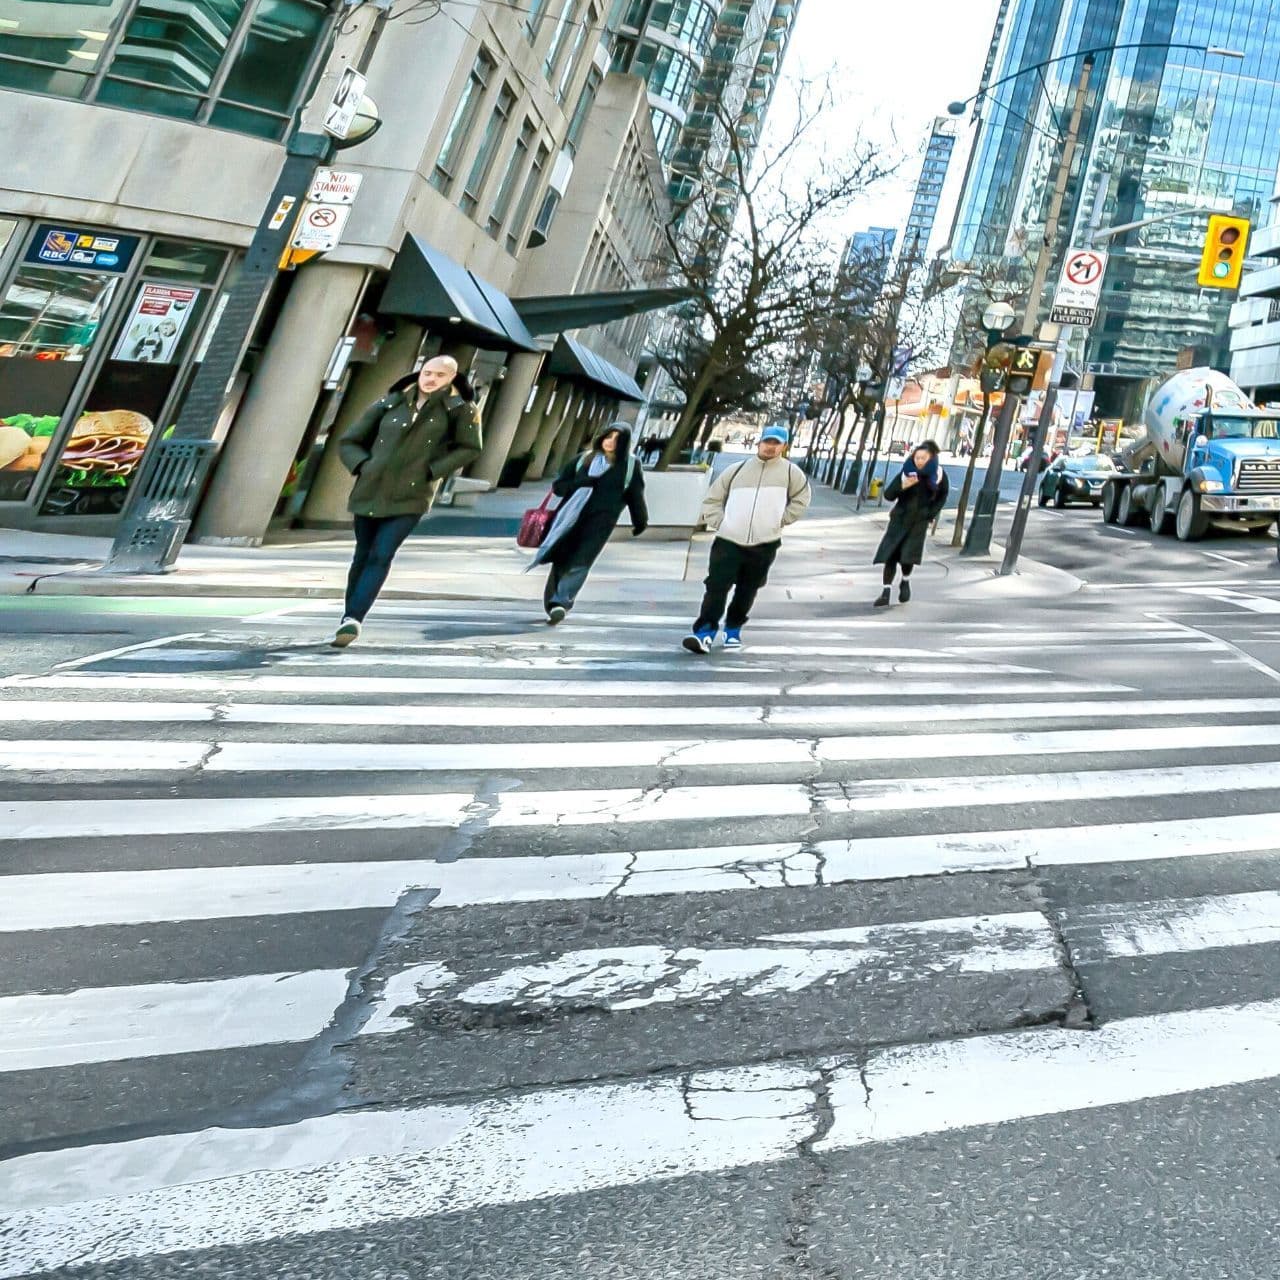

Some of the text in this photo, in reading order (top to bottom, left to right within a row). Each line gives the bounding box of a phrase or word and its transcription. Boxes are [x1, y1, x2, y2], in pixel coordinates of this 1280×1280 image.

[329, 173, 347, 183] NO
[313, 181, 355, 193] STANDING
[42, 250, 67, 259] RBC
